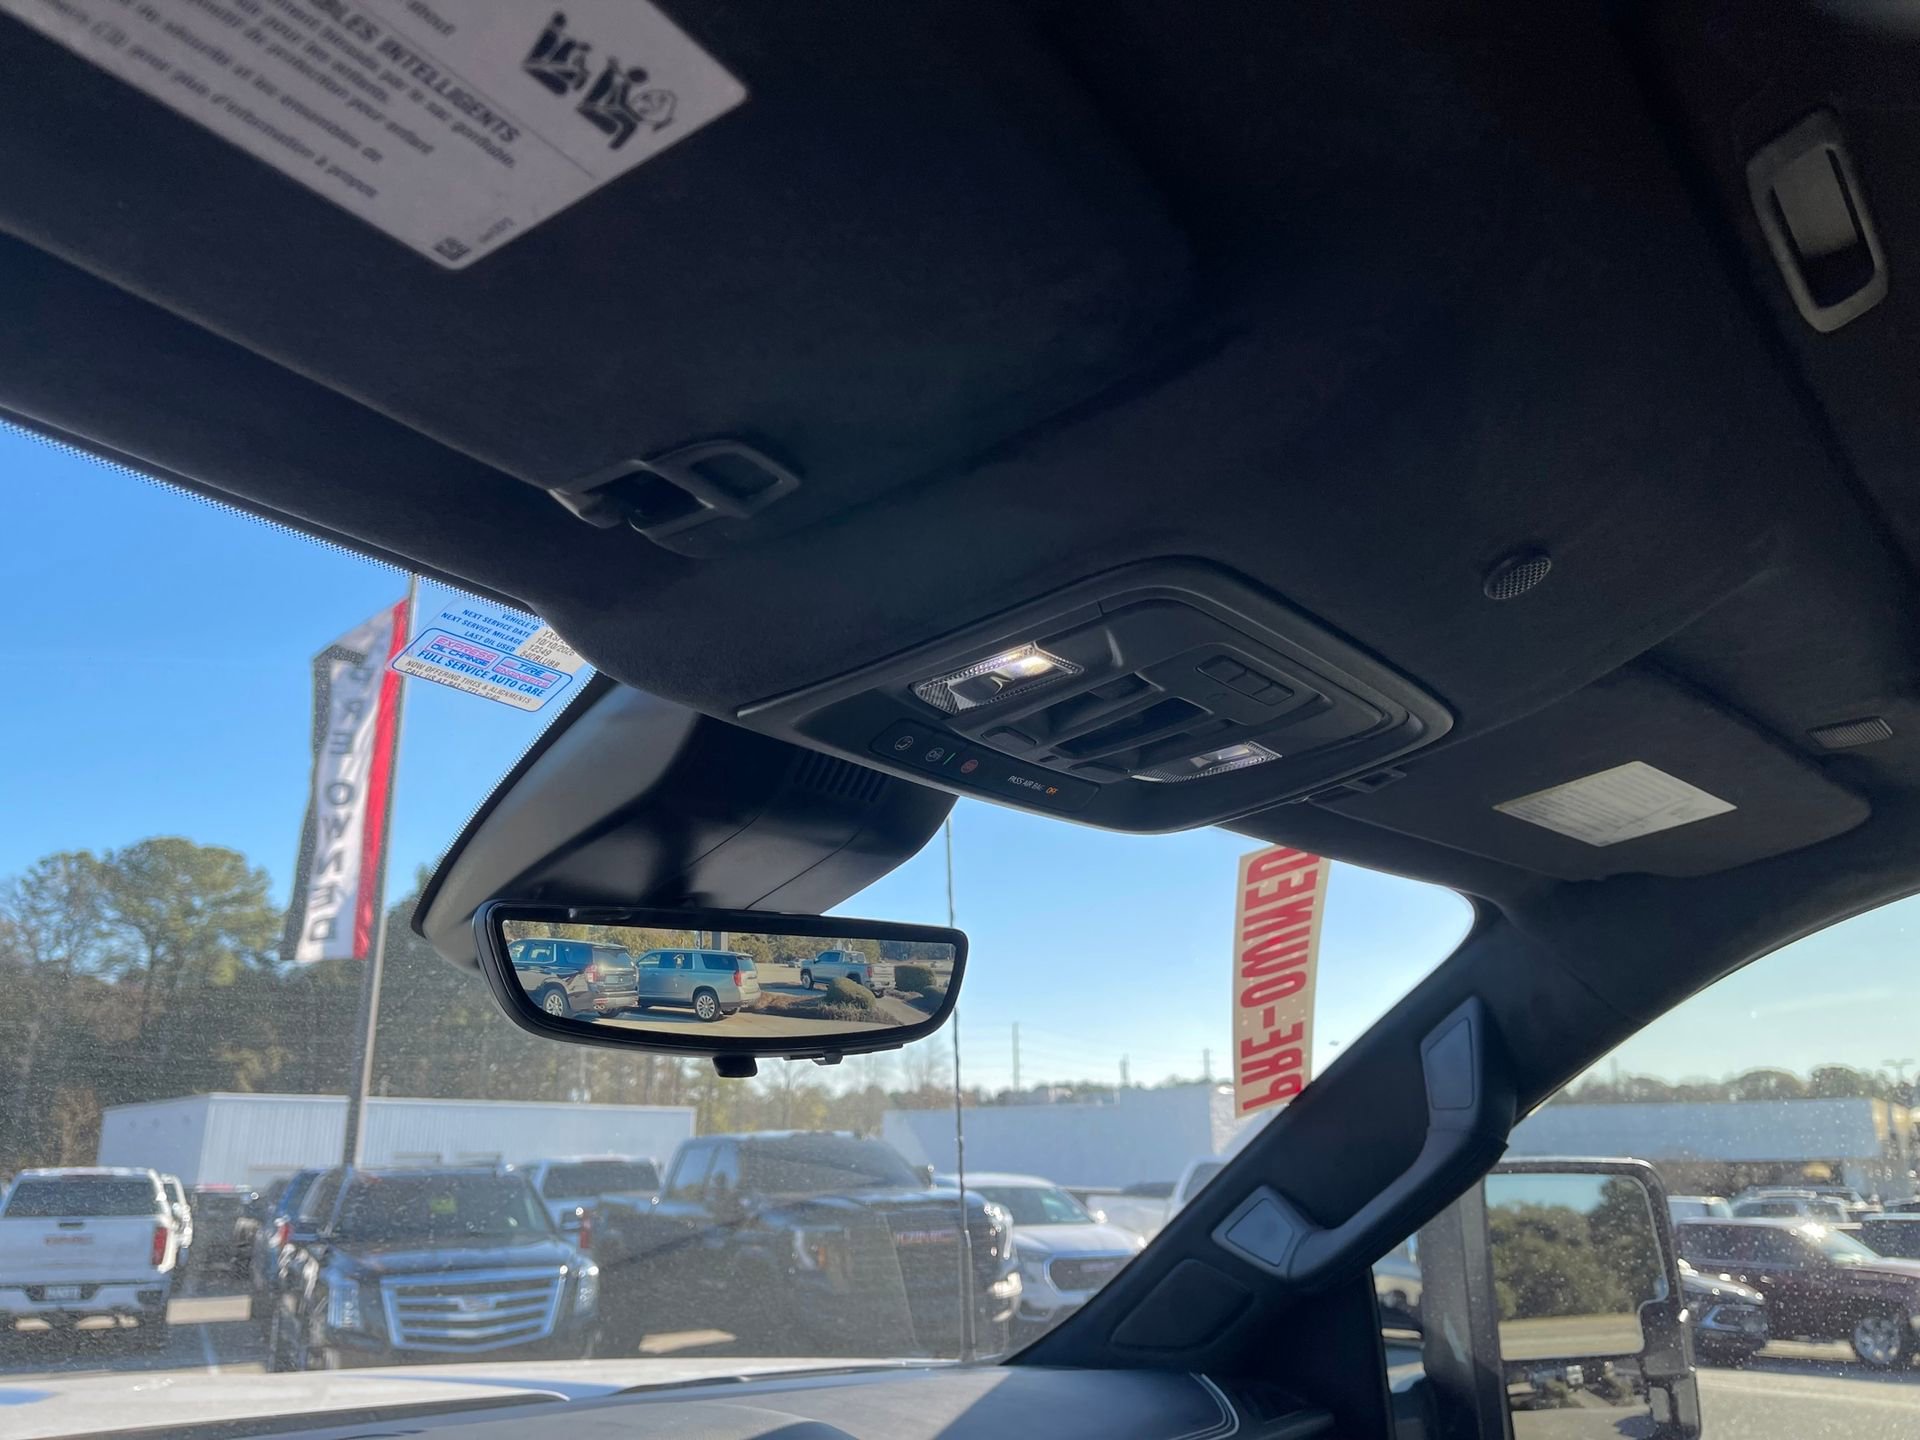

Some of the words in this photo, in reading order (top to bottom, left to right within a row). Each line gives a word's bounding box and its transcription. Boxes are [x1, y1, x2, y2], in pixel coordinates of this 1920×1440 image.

[379, 36, 519, 143] INTELLIGENTS
[441, 612, 460, 623] NEXT
[461, 620, 493, 634] SERVICE
[493, 630, 524, 645] MILEAGE
[462, 609, 482, 620] NEXT
[482, 615, 512, 632] SERVICE
[512, 625, 532, 638] DATE
[502, 613, 530, 628] VEHICLE
[530, 623, 540, 631] ID
[431, 643, 447, 653] OIL
[448, 648, 490, 666] CHANGE
[435, 637, 496, 661] EXPRESS
[464, 631, 483, 640] LAST
[483, 637, 495, 645] OIL
[496, 640, 516, 652] USED
[405, 660, 424, 669] NOW
[424, 665, 462, 680] OFFERING
[463, 677, 482, 688] TIRES
[489, 685, 532, 704] ALIGNMENTS
[418, 650, 444, 664] FULL
[445, 659, 491, 678] SERVICE
[489, 674, 518, 687] AUTO
[518, 683, 546, 697] CARE
[518, 663, 546, 677] TIRE
